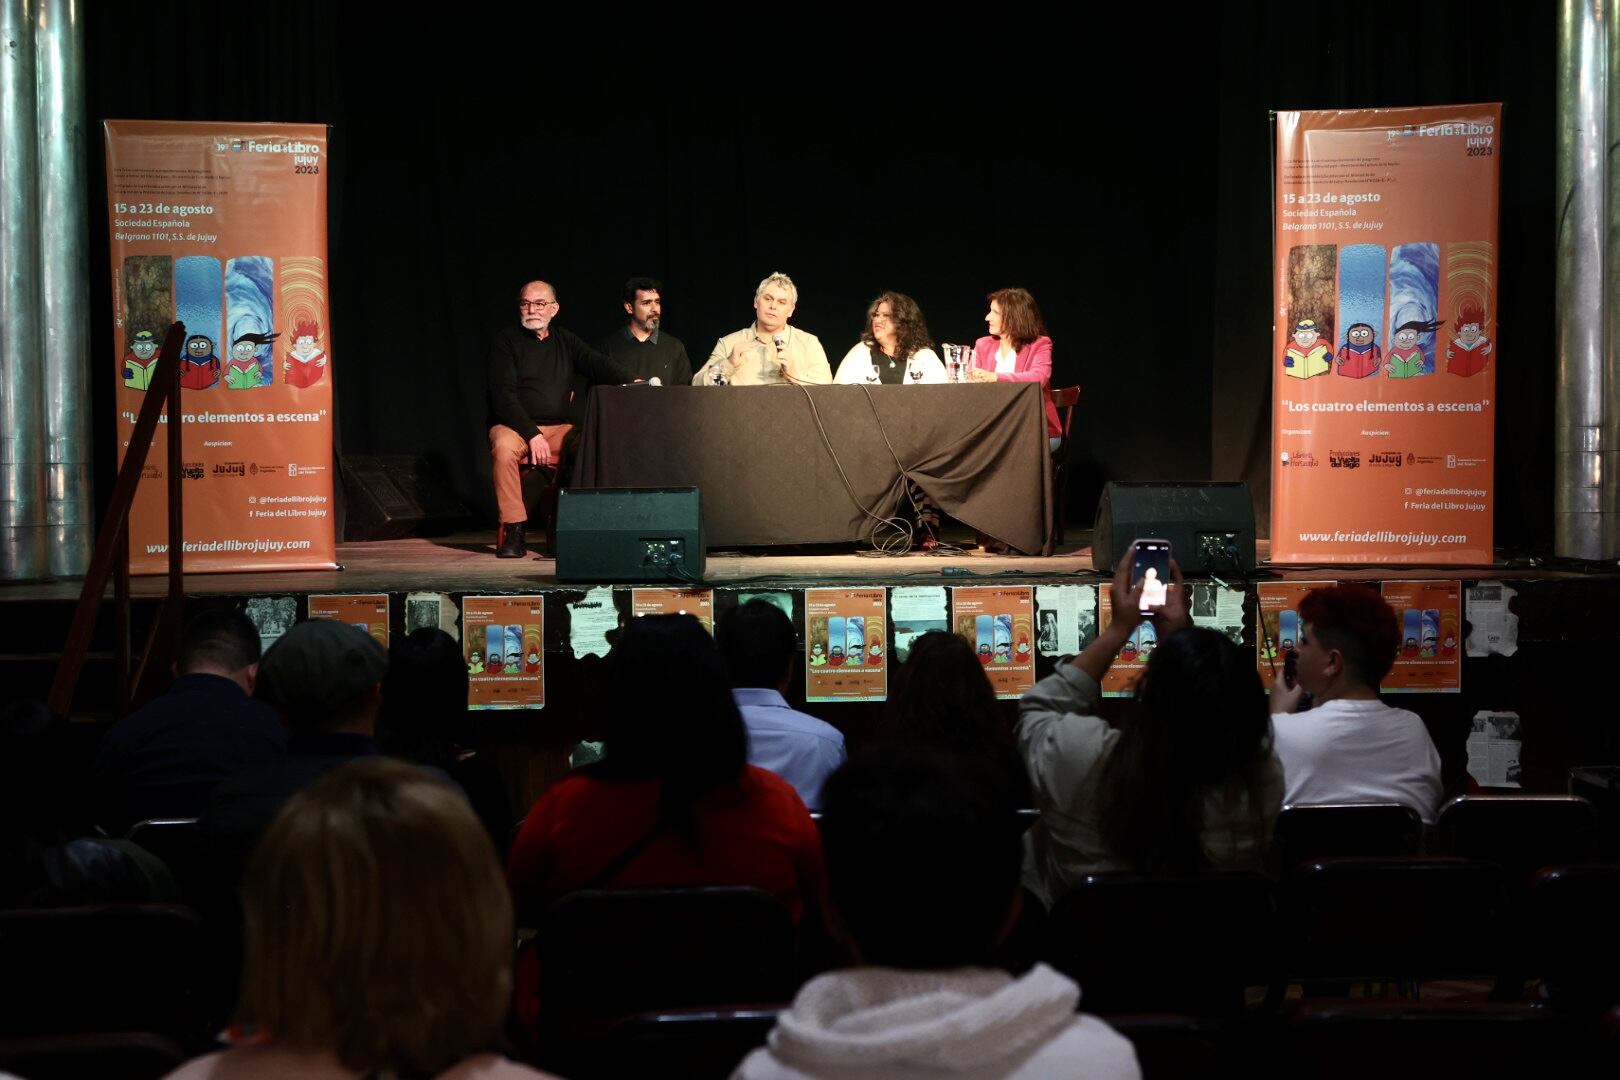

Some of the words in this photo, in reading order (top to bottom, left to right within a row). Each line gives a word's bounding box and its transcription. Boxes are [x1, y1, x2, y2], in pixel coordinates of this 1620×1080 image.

[1418, 125, 1453, 137] Feria
[1460, 122, 1494, 135] Libro
[248, 140, 281, 153] Feria
[287, 141, 320, 154] Libro
[1466, 135, 1493, 148] jujuy
[1466, 147, 1493, 157] 2023
[293, 153, 319, 166] jujuy
[294, 165, 320, 175] 2023
[1282, 193, 1296, 204] 15
[1298, 196, 1305, 204] a
[1307, 193, 1321, 204] 23
[1324, 192, 1338, 203] de
[1340, 193, 1381, 206] agosto
[114, 203, 128, 214] 15
[130, 206, 137, 214] a
[138, 203, 154, 215] 23
[155, 203, 170, 215] de
[172, 204, 214, 217] agosto
[1282, 208, 1319, 217] Sociedad
[1319, 207, 1357, 218] Española
[114, 218, 152, 228] Sociedad
[153, 219, 191, 229] Española
[1282, 221, 1317, 232] Belgrano
[1318, 221, 1337, 232] 1101,
[1338, 221, 1351, 230] S.S.
[1352, 221, 1363, 230] de
[1363, 221, 1384, 232] Jujuy
[114, 232, 152, 243] Belgrano
[172, 233, 186, 242] S.S.
[186, 232, 197, 242] de
[197, 232, 218, 244] Jujuy
[1281, 400, 1310, 413] “Los
[1311, 401, 1354, 413] cuatro
[1355, 400, 1425, 413] elementos
[1426, 402, 1434, 412] a
[1436, 399, 1490, 413] escena”
[197, 411, 265, 424] elementos
[266, 413, 275, 423] a
[1415, 487, 1487, 498] @feriadellibrojujuy
[258, 494, 327, 505] @feriadellibrojujuy
[1410, 502, 1431, 510] Feria
[1431, 502, 1444, 510] del
[1444, 502, 1465, 510] Libro
[1465, 502, 1487, 512] Jujuy
[255, 510, 273, 518] Feria
[274, 509, 287, 517] del
[288, 509, 307, 517] Libro
[307, 508, 327, 519] Jujuy
[1299, 530, 1467, 546] www.feriadellibrojujuy.com
[146, 538, 311, 554] wwferiadellibrojujuy.com
